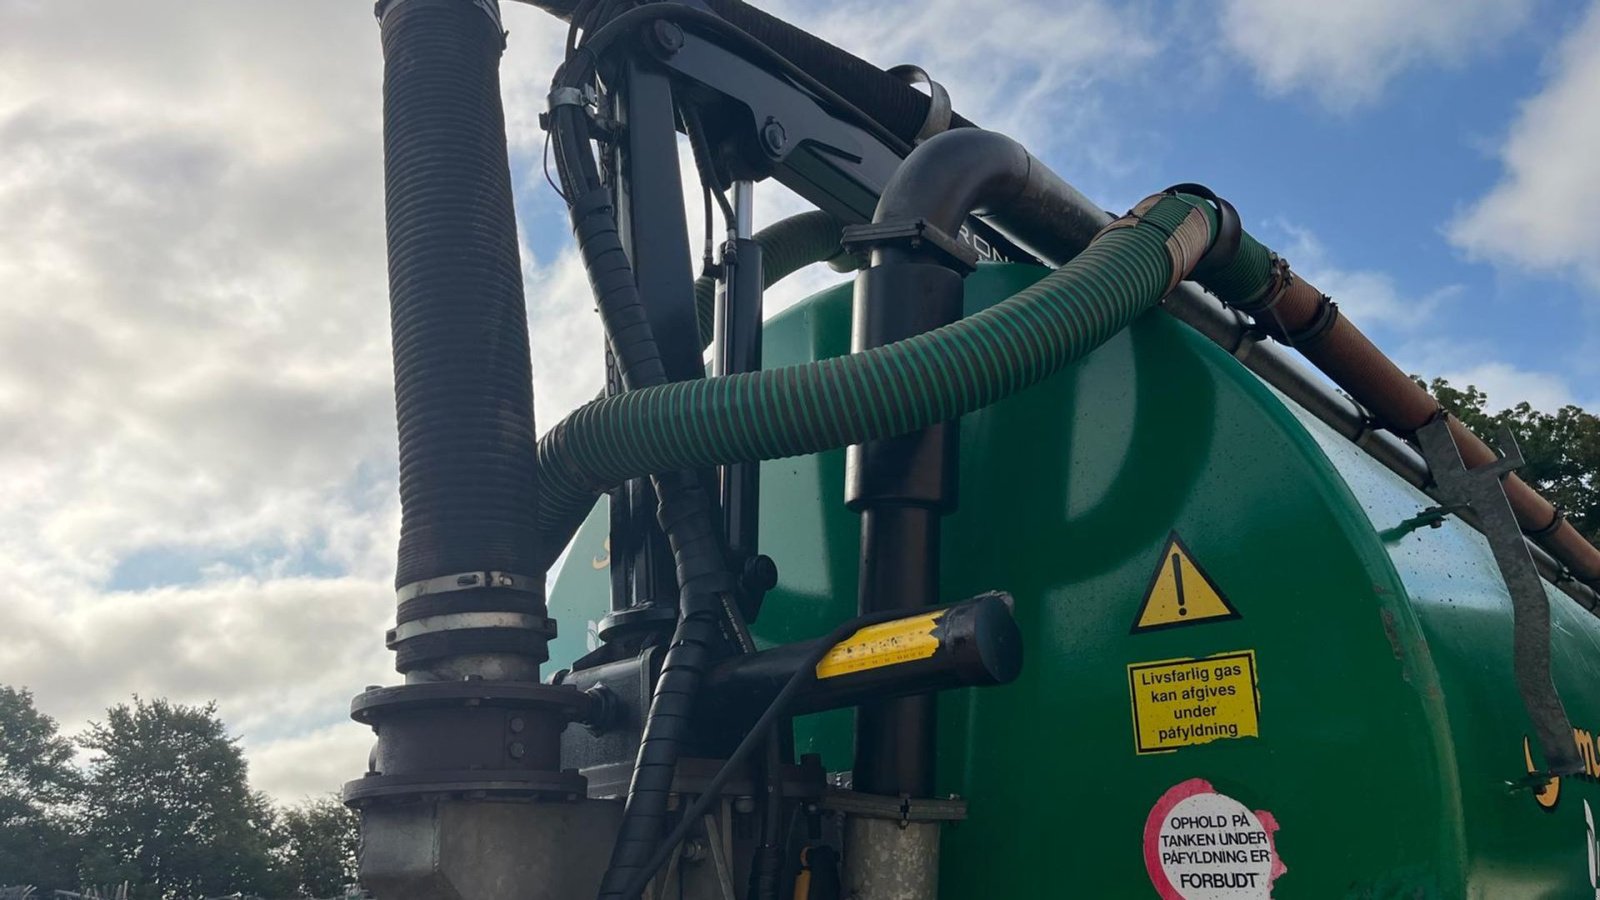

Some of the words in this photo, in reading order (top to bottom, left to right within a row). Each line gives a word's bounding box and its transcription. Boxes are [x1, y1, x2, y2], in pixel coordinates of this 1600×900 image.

[1141, 667, 1209, 686] Livsfarlig
[1214, 665, 1242, 681] gas
[1151, 690, 1177, 703] kan
[1182, 684, 1236, 701] afgives
[1173, 704, 1217, 720] under
[1158, 722, 1238, 743] påfyldning
[1170, 815, 1227, 830] OPHOLD
[1231, 811, 1251, 828] PÅ
[1161, 833, 1216, 847] TANKEN
[1219, 832, 1268, 846] UNDER
[1163, 849, 1248, 865] PÅFYLDNING
[1250, 849, 1271, 863] ER
[1180, 872, 1259, 889] FORBUDT
